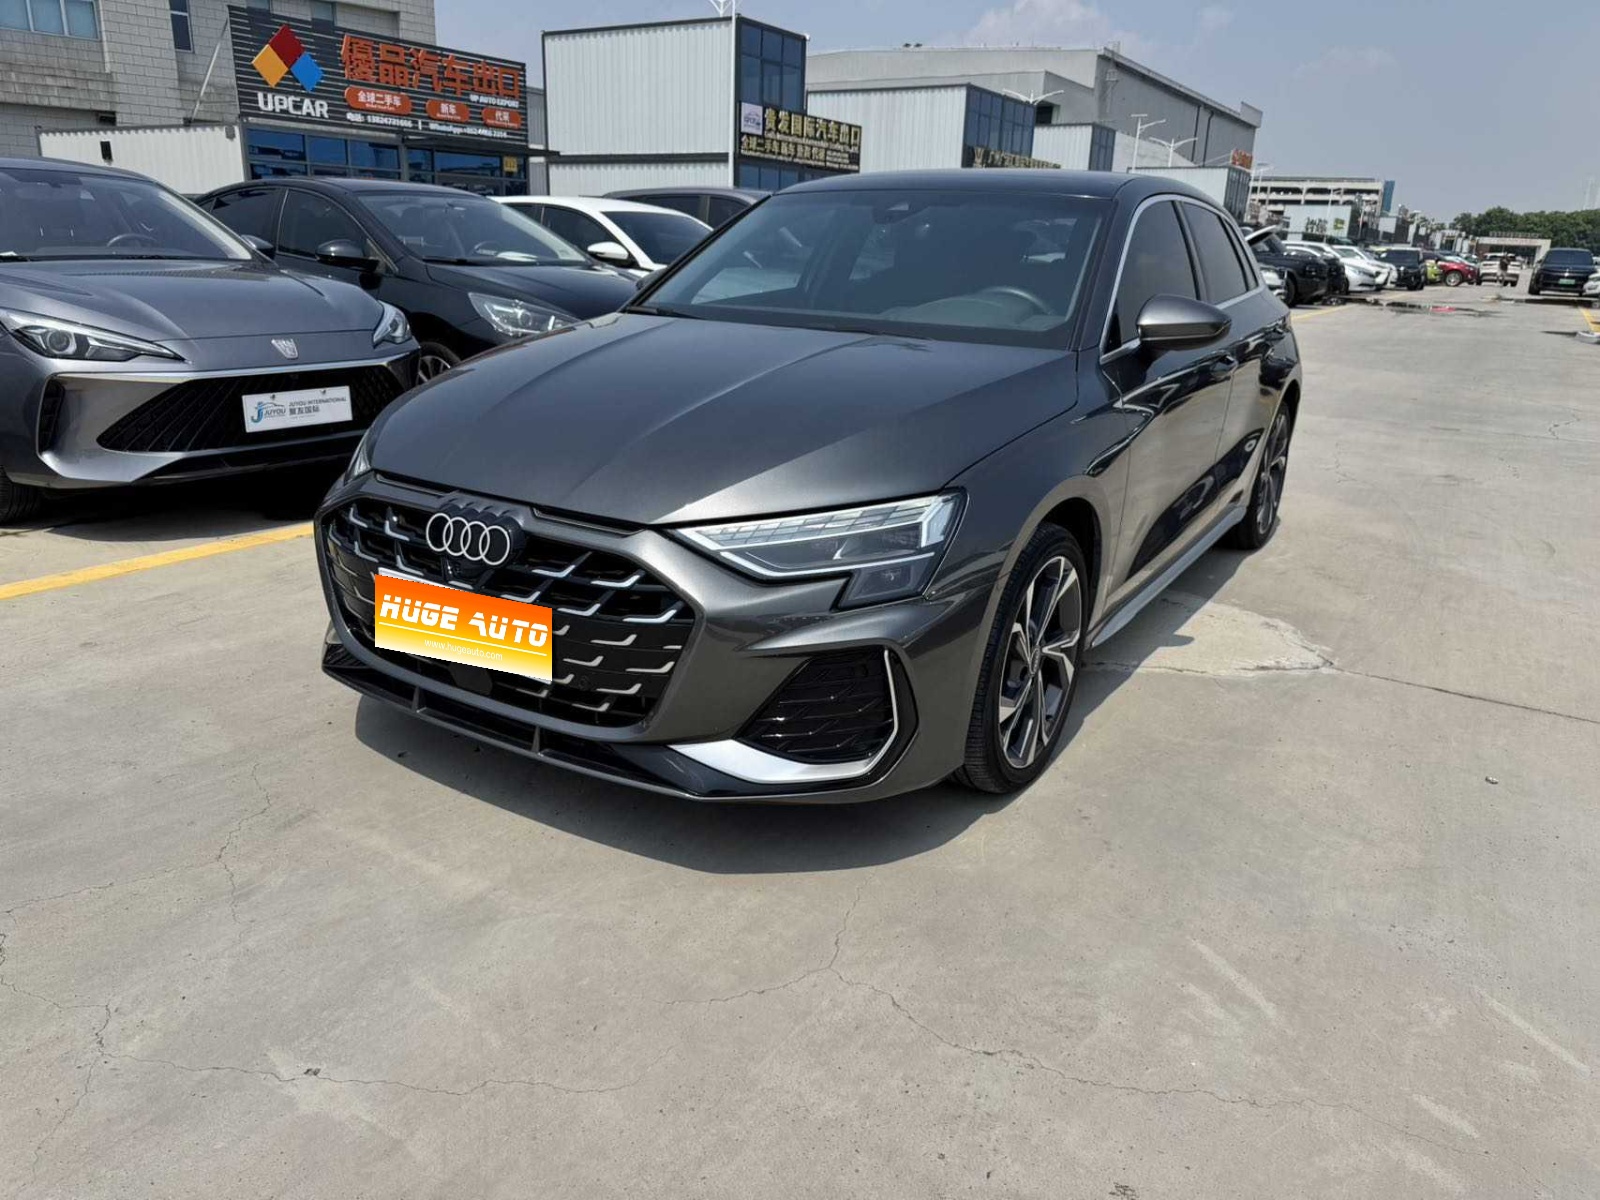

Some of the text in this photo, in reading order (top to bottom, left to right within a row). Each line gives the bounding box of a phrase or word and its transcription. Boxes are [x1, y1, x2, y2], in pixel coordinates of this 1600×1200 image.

[257, 91, 329, 119] UPCAR
[357, 90, 401, 107] 全球二手车
[440, 103, 457, 114] 新车
[307, 397, 347, 405] INTERNATIONAL
